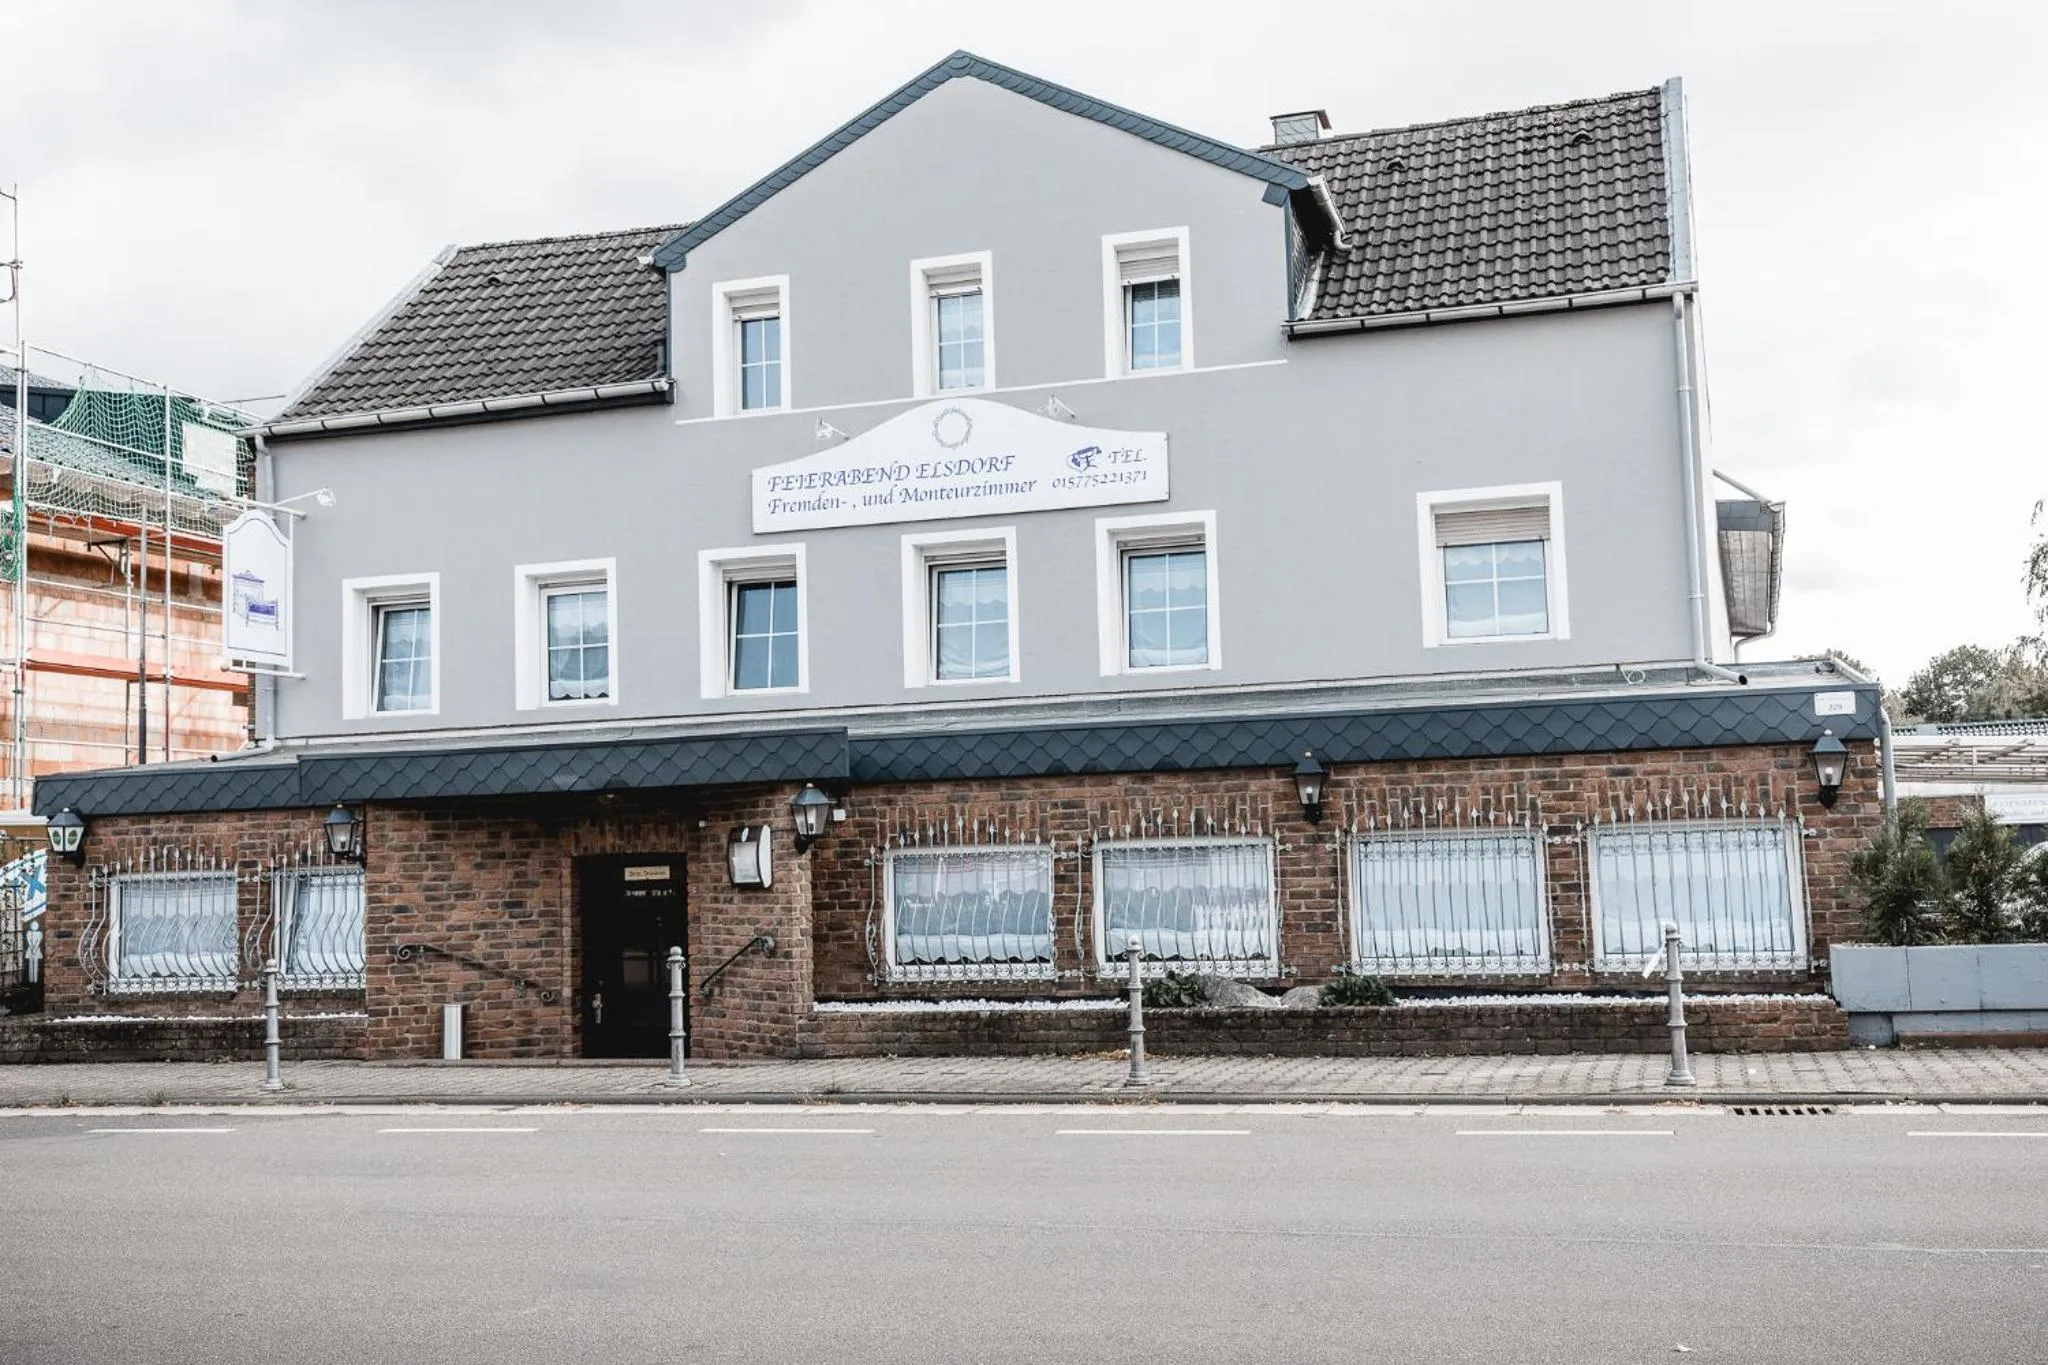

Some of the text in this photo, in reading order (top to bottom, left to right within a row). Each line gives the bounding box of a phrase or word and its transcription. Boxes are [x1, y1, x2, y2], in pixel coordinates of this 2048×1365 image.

[768, 455, 1015, 492] FEIERABEND ELSDORF
[863, 484, 897, 507] und
[900, 480, 1037, 503] Monteurzimmer
